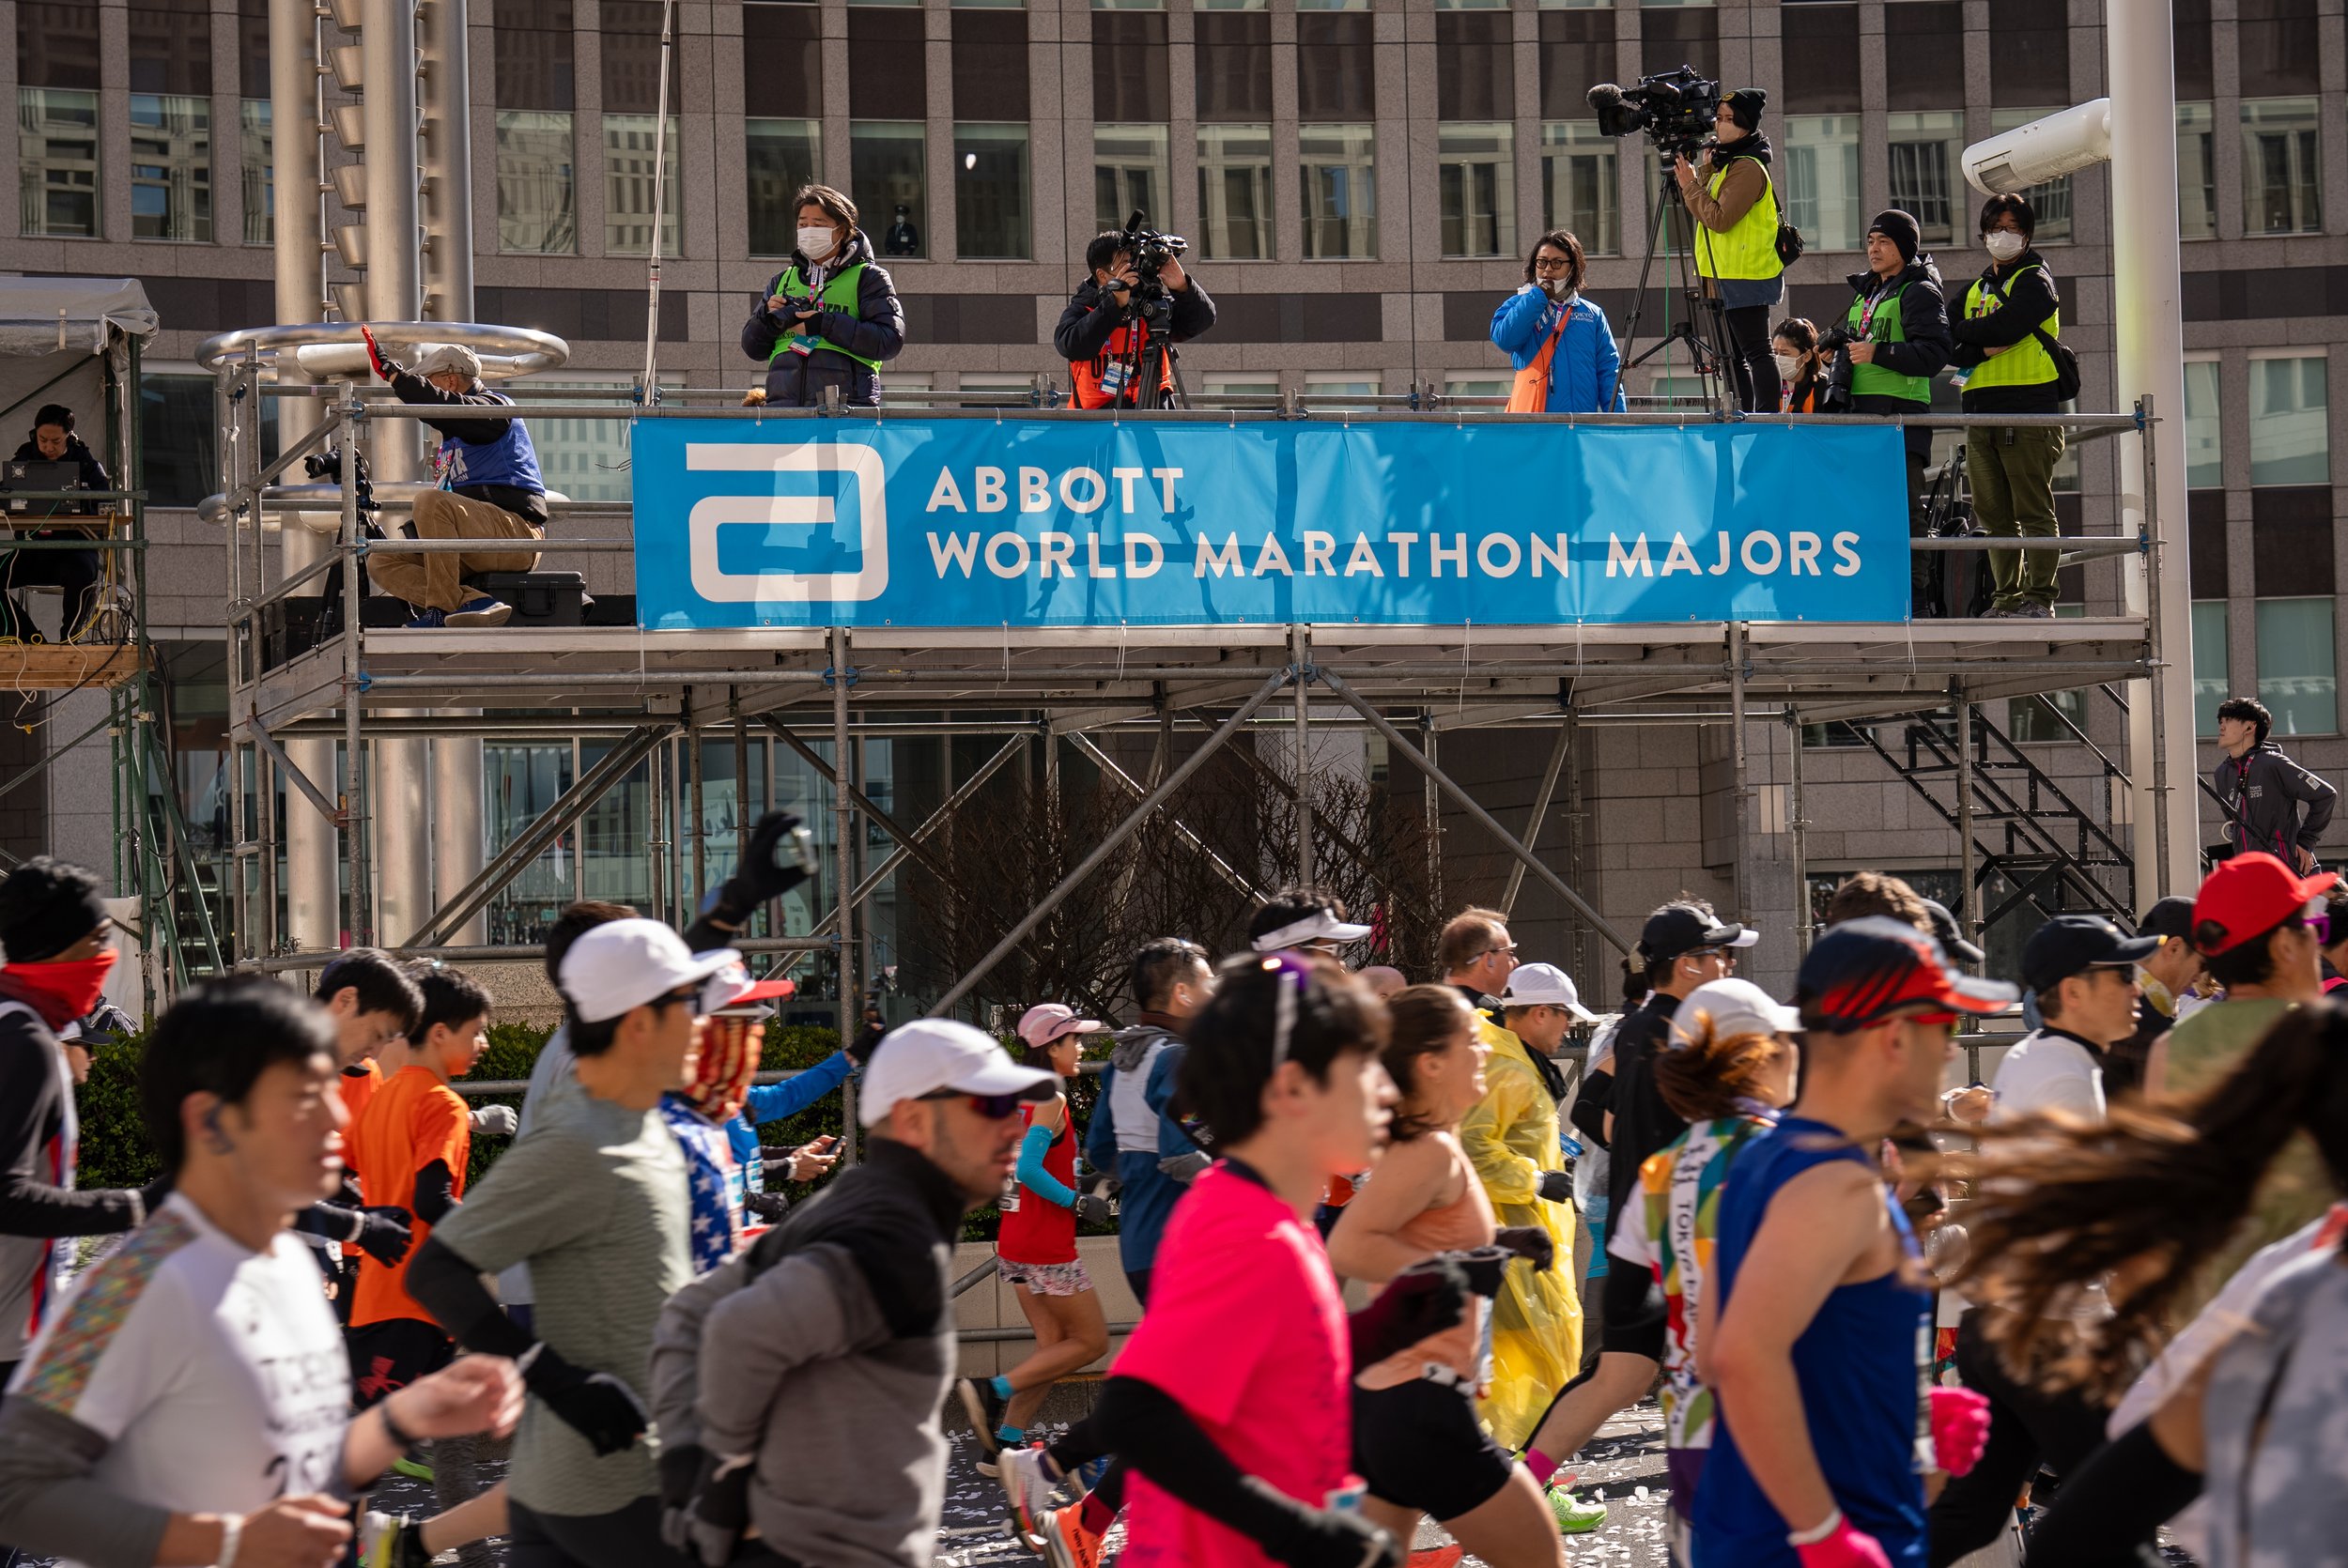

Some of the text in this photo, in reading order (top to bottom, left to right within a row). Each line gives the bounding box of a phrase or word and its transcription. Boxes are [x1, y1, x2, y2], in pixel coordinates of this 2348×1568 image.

[926, 466, 1183, 514] ABBOTT
[927, 531, 1861, 578] WORLD MARATHON MAJORS
[1676, 1202, 1694, 1279] TOKYO
